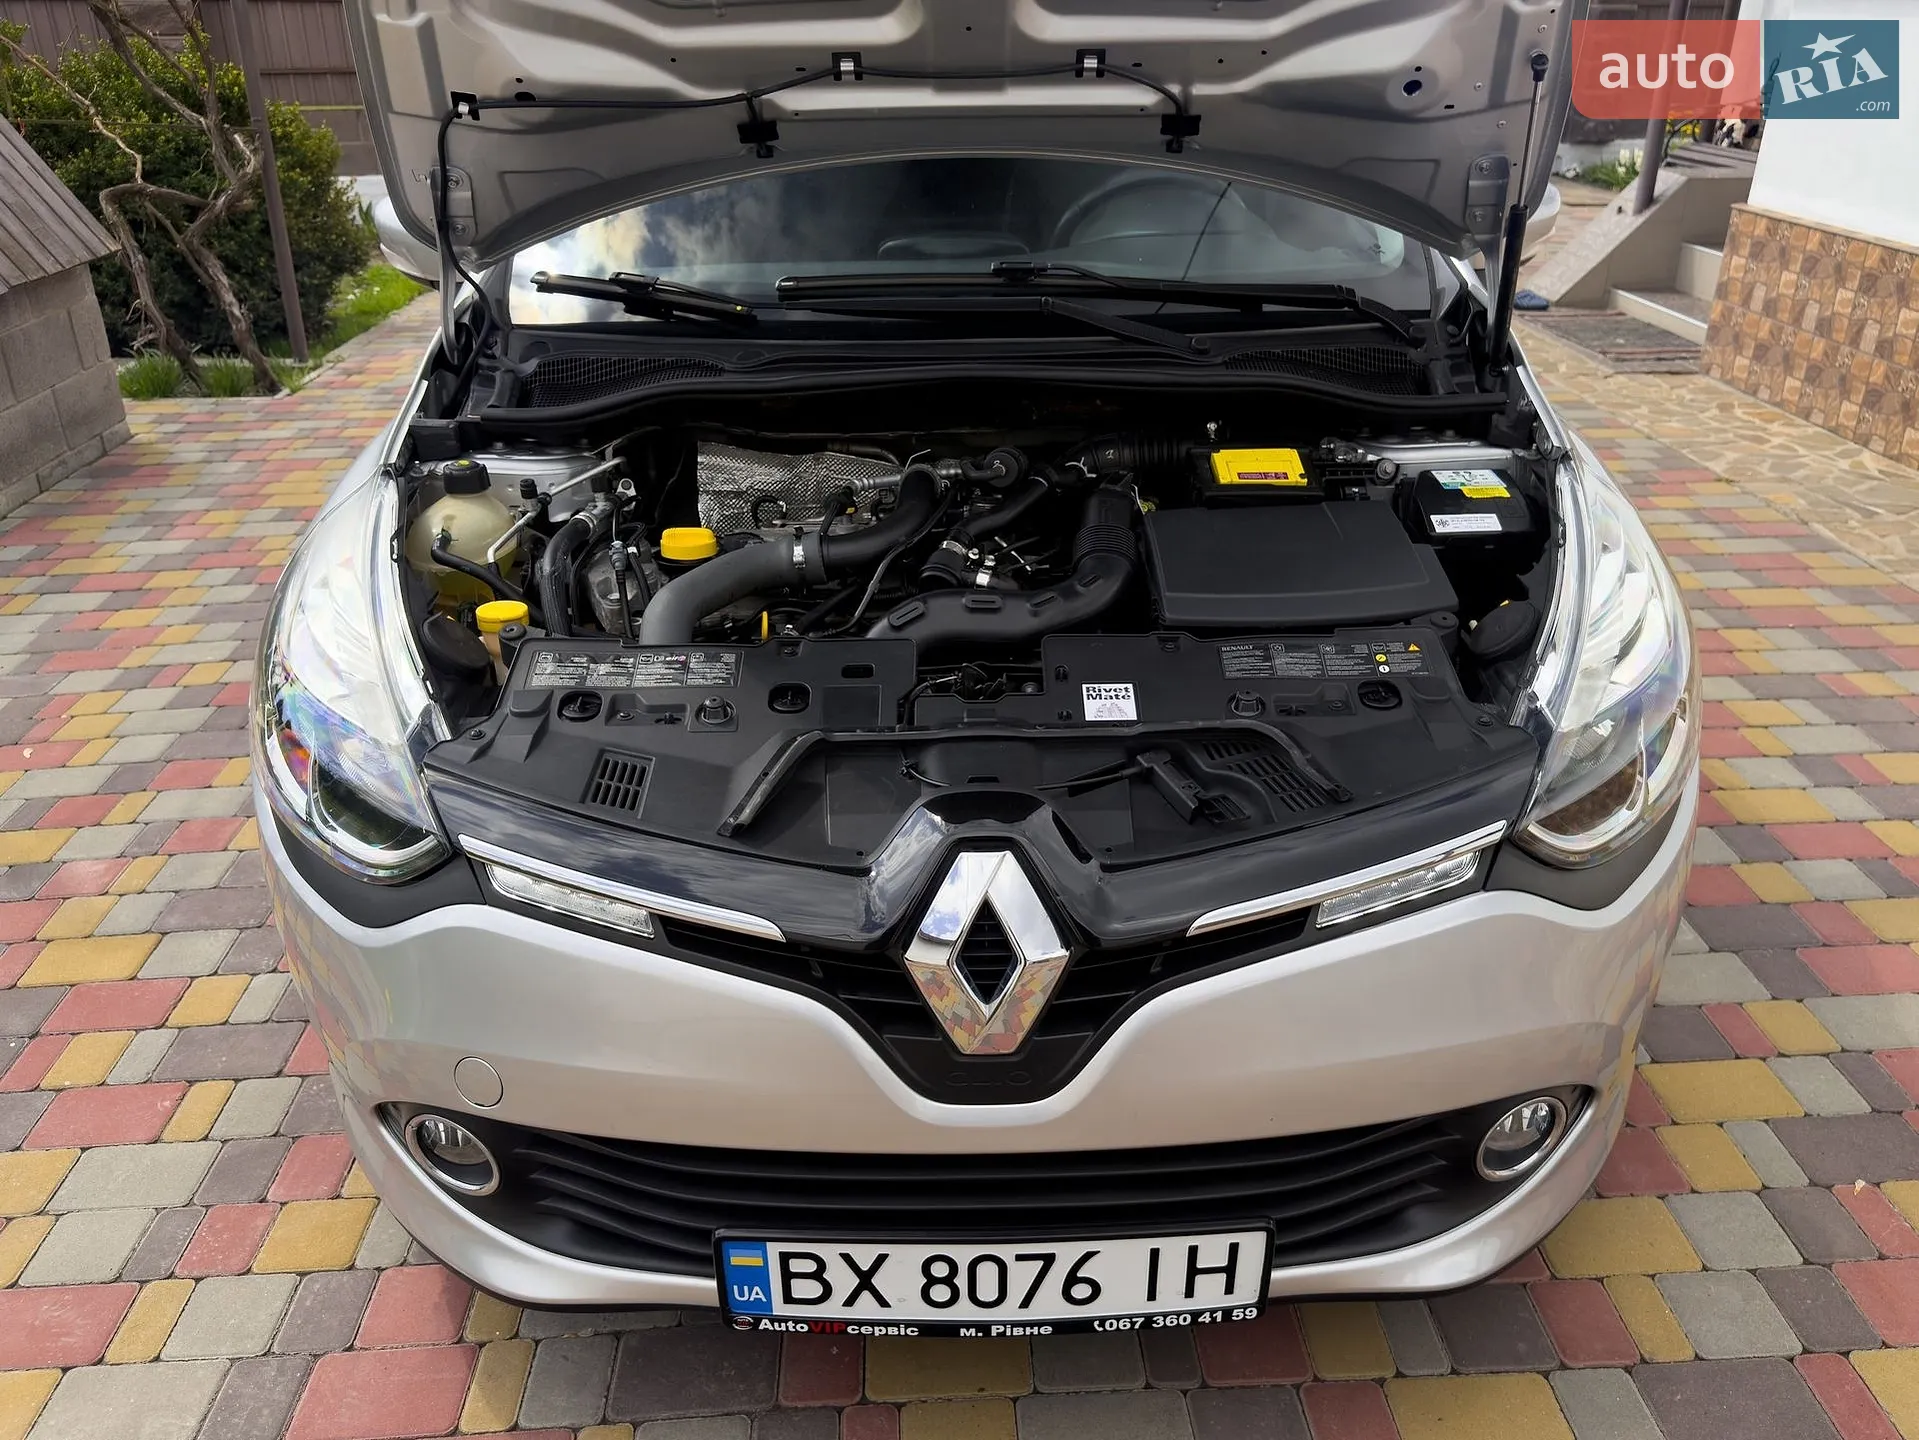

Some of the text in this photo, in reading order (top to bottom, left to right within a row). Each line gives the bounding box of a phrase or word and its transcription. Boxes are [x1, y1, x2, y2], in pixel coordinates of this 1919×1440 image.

[778, 1241, 1240, 1309] BX 8076 IH
[733, 1285, 767, 1303] UA
[991, 1325, 1053, 1337] Рівне
[1104, 1317, 1145, 1331] 067
[1152, 1314, 1192, 1328] 360
[1198, 1311, 1223, 1324] 41
[1231, 1307, 1258, 1320] 59
